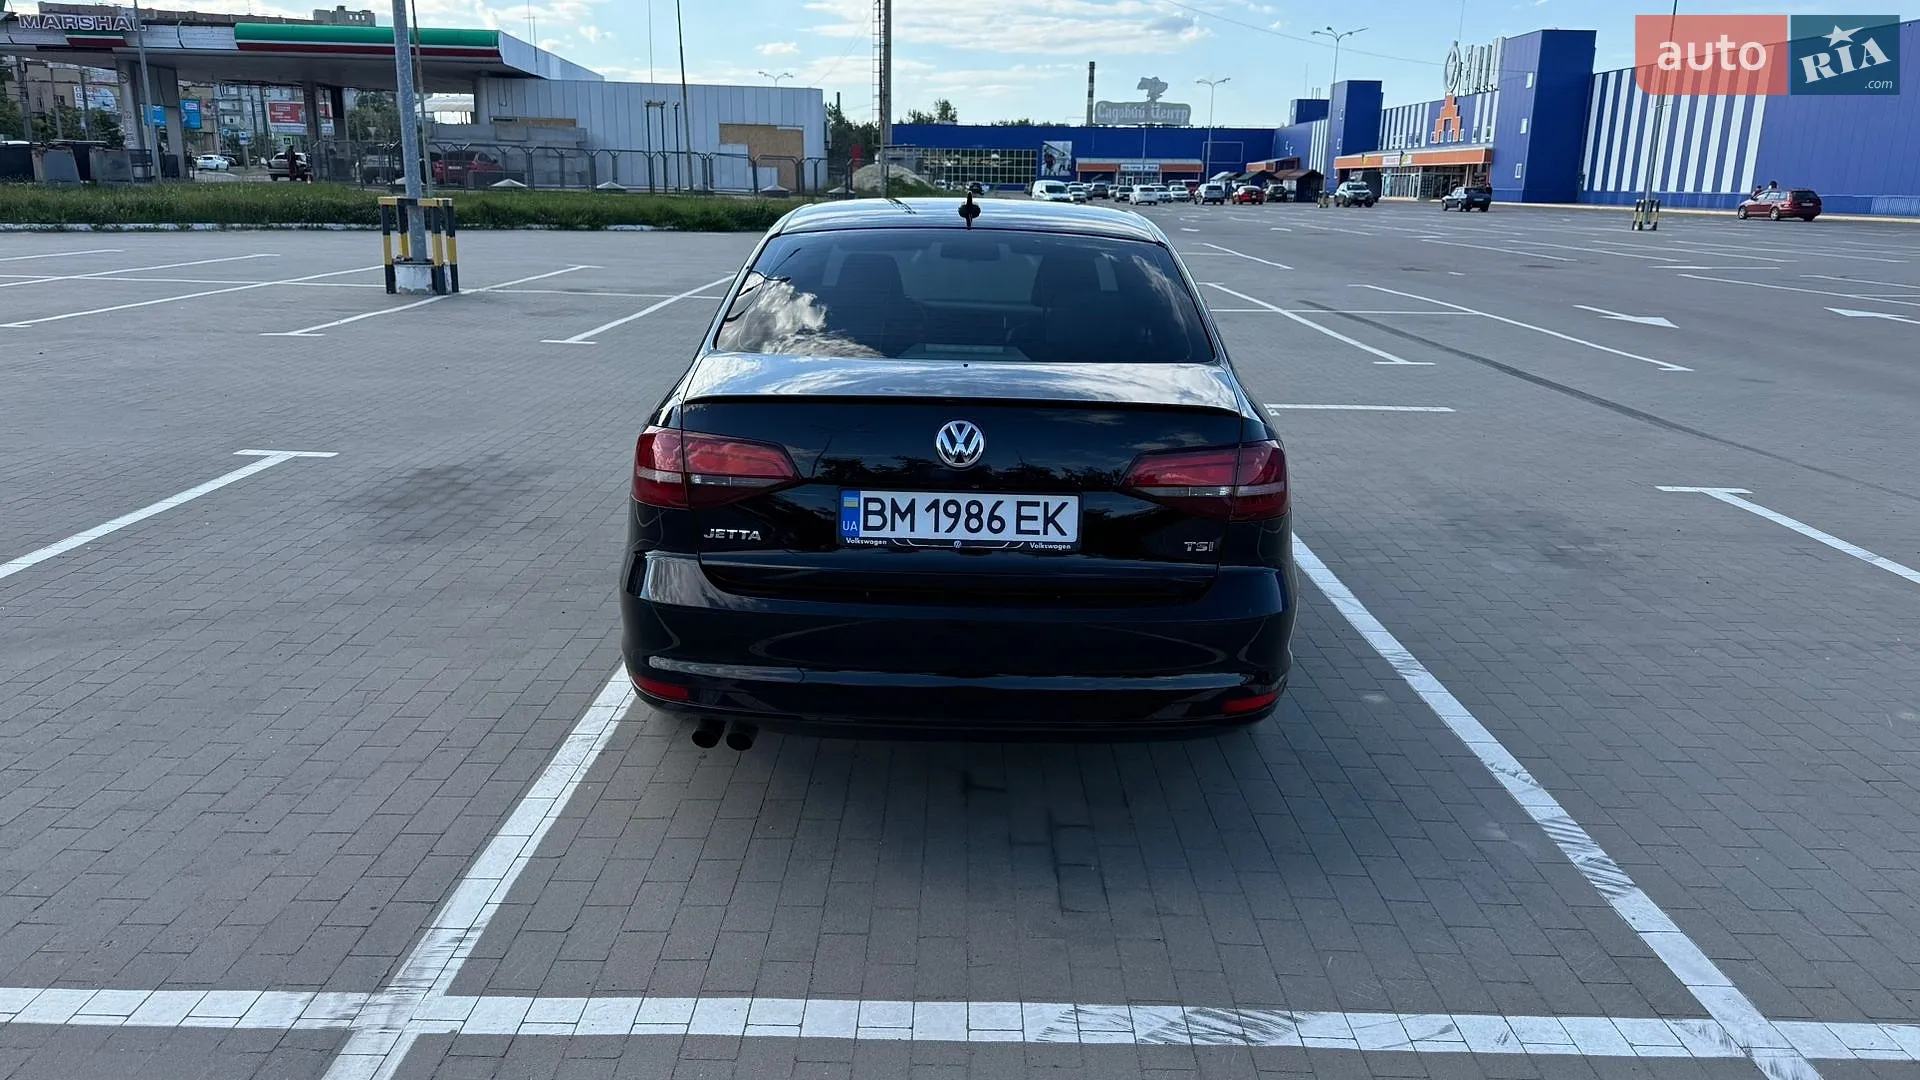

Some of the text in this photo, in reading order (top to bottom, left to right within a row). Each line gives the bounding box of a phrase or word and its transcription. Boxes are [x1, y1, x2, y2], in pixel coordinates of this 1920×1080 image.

[1151, 103, 1188, 123] Центр
[842, 496, 1069, 537] UA BM 1986 EK
[703, 528, 762, 541] JETTA
[846, 537, 887, 546] Volkswagen
[1030, 542, 1071, 551] Volkswagen
[1183, 541, 1215, 552] TSI
